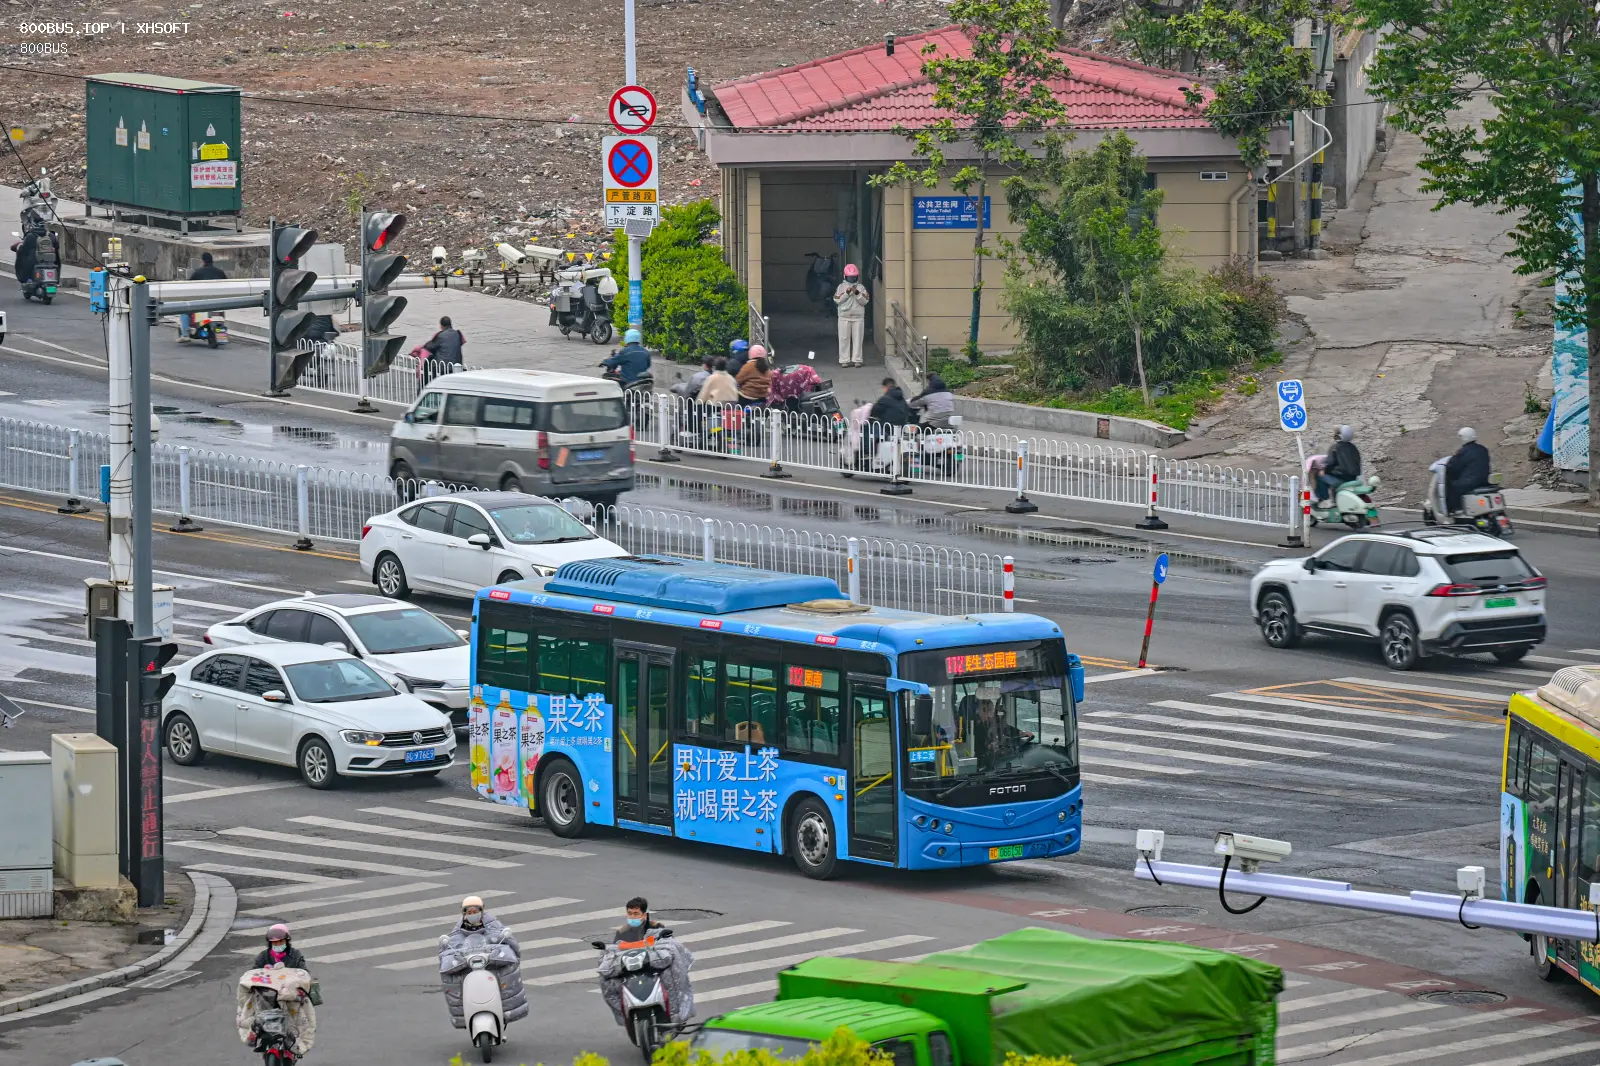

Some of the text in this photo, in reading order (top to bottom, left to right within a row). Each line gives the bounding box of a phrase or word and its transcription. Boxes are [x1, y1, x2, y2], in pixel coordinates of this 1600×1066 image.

[611, 191, 652, 200] 严管路段
[610, 206, 653, 216] 下淀路
[918, 200, 958, 209] 公共卫生间
[635, 609, 652, 619] 果之茶
[744, 624, 760, 634] 果之茶
[860, 640, 878, 650] 果之茶
[946, 655, 964, 674] 112
[547, 693, 605, 734] 果之茶
[469, 722, 490, 738] 果之茶
[493, 727, 517, 744] 果之茶
[521, 731, 545, 748] 果之茶
[674, 744, 779, 782] 果汁爱上茶
[910, 750, 936, 762] 上车二元
[141, 719, 158, 857] 行人禁止通行
[989, 784, 1027, 796] FOTON
[674, 788, 778, 823] 就喝果之茶
